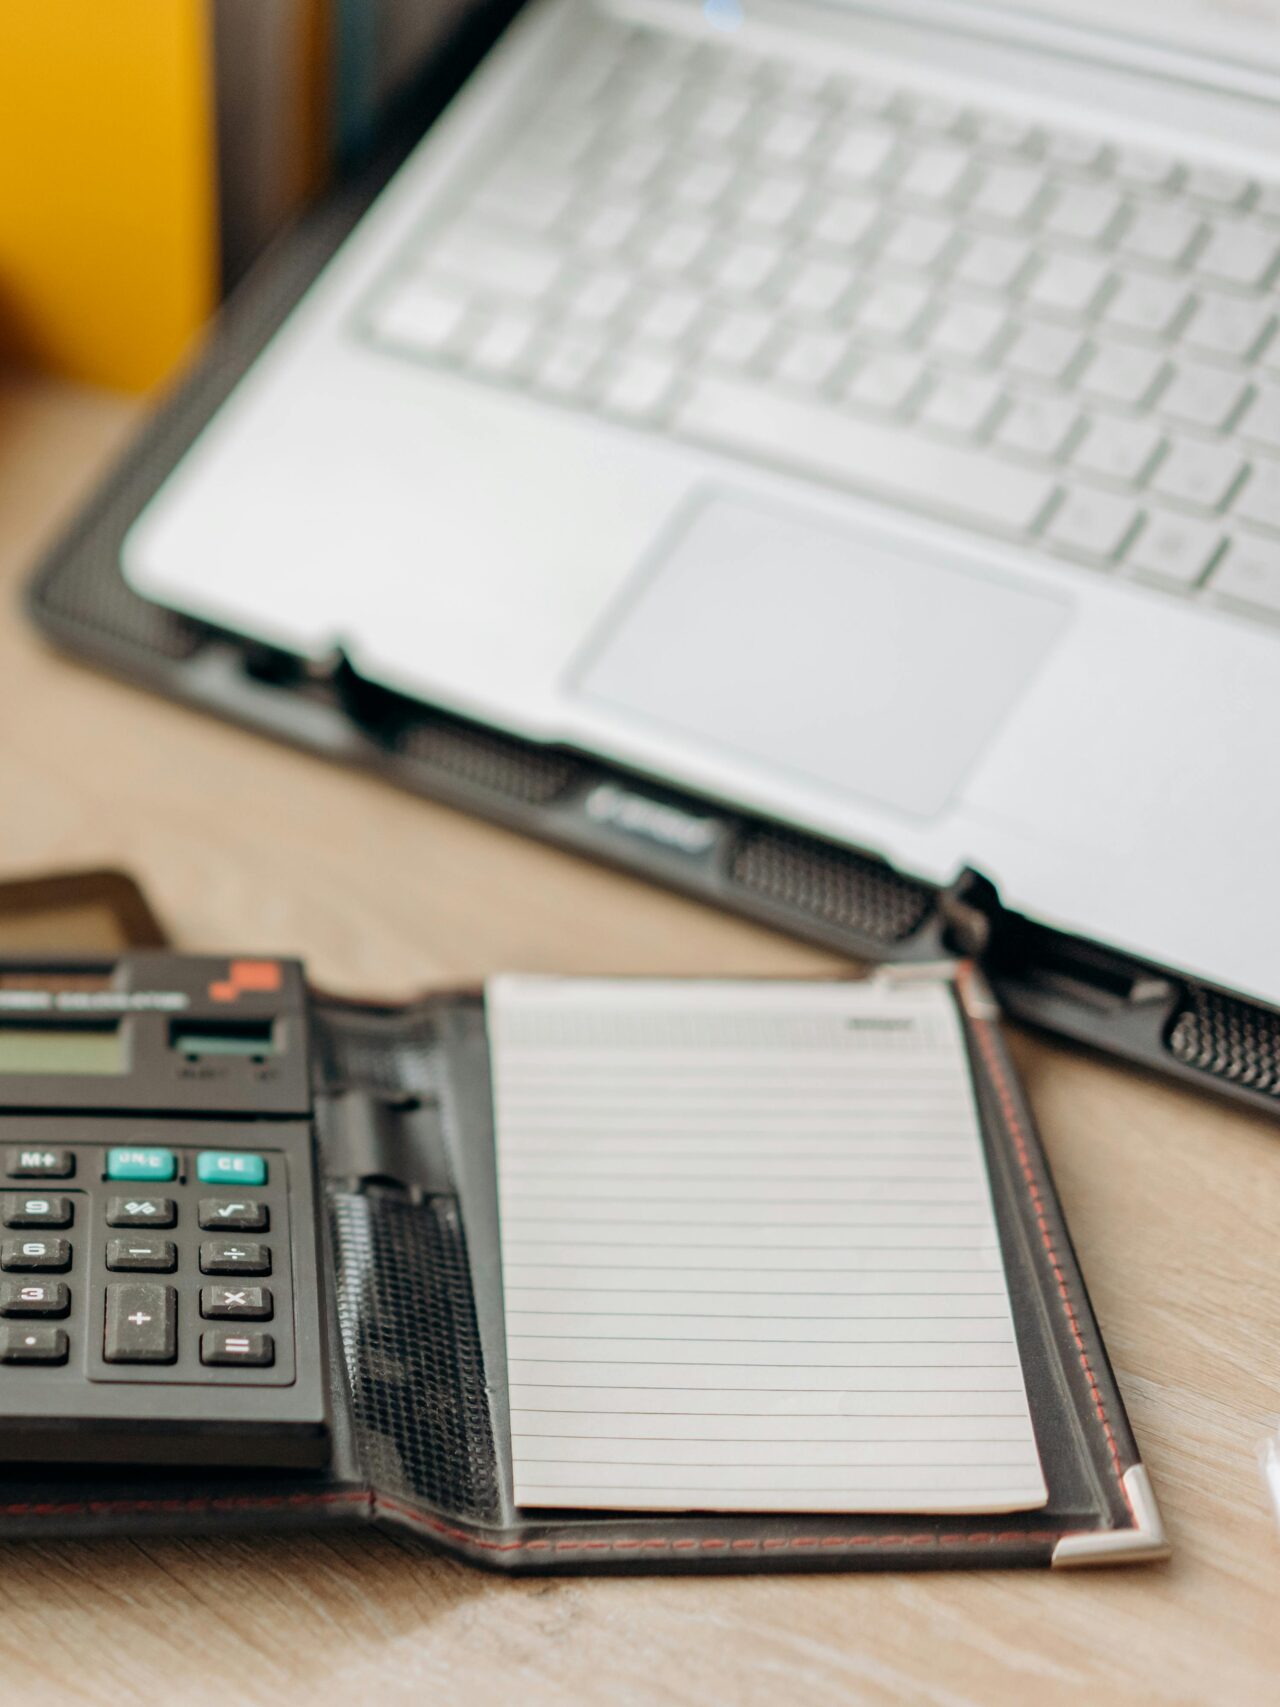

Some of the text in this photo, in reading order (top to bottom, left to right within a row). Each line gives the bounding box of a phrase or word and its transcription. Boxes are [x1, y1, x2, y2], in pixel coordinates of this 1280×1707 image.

[21, 1152, 56, 1167] M+
[217, 1157, 245, 1171] CE
[25, 1200, 49, 1214] 9
[22, 1243, 46, 1256] 6
[20, 1287, 44, 1300] 3
